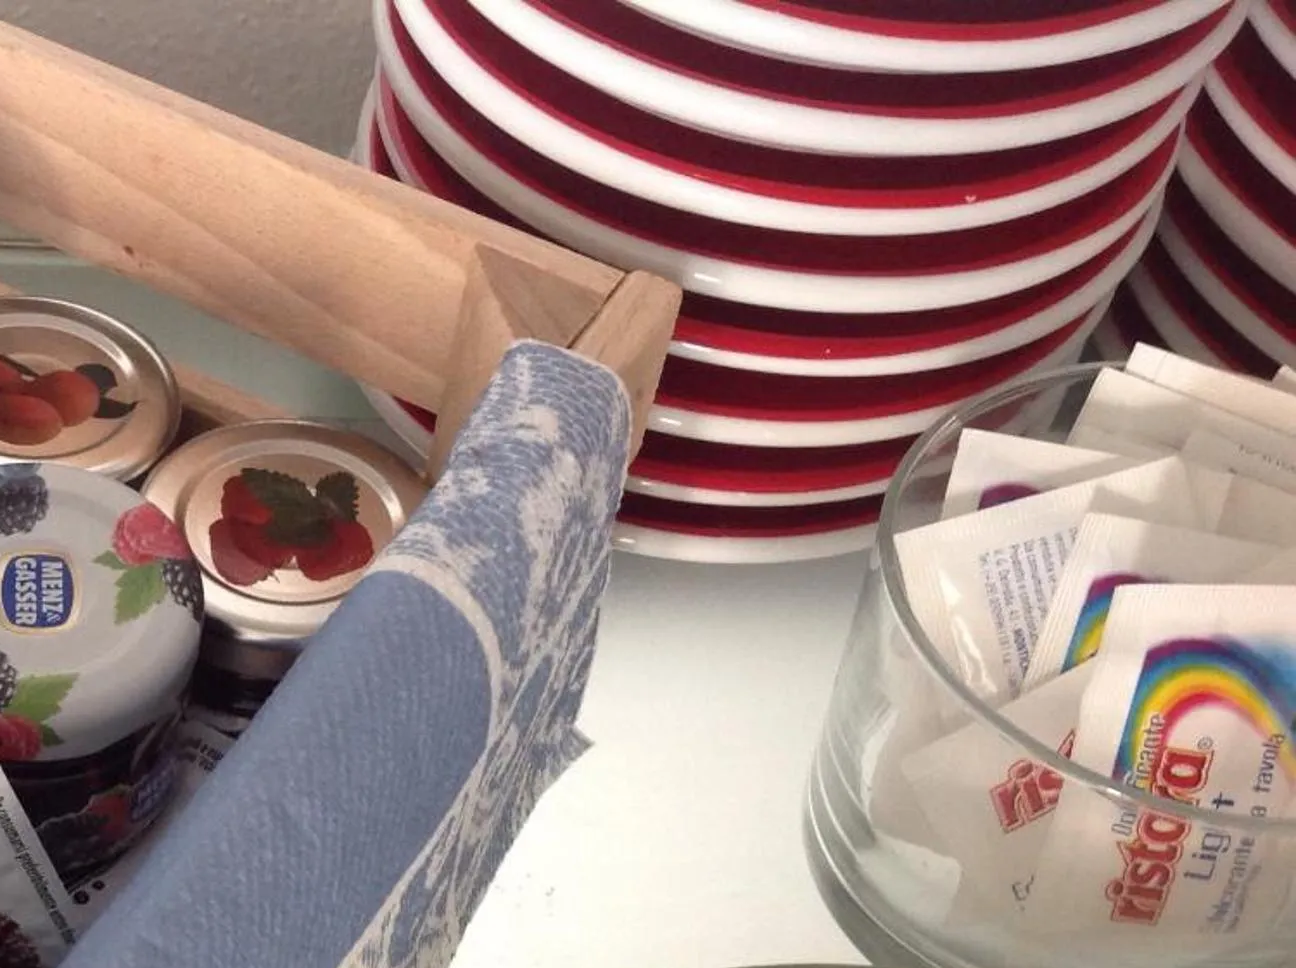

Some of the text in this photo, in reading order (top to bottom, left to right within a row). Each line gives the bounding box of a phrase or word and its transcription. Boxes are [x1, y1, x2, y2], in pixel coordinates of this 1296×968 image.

[15, 558, 37, 625] GASSER
[991, 745, 1070, 832] ris
[1111, 713, 1165, 837] Doficante
[1254, 732, 1286, 793] tavola
[1184, 792, 1235, 881] Ligt
